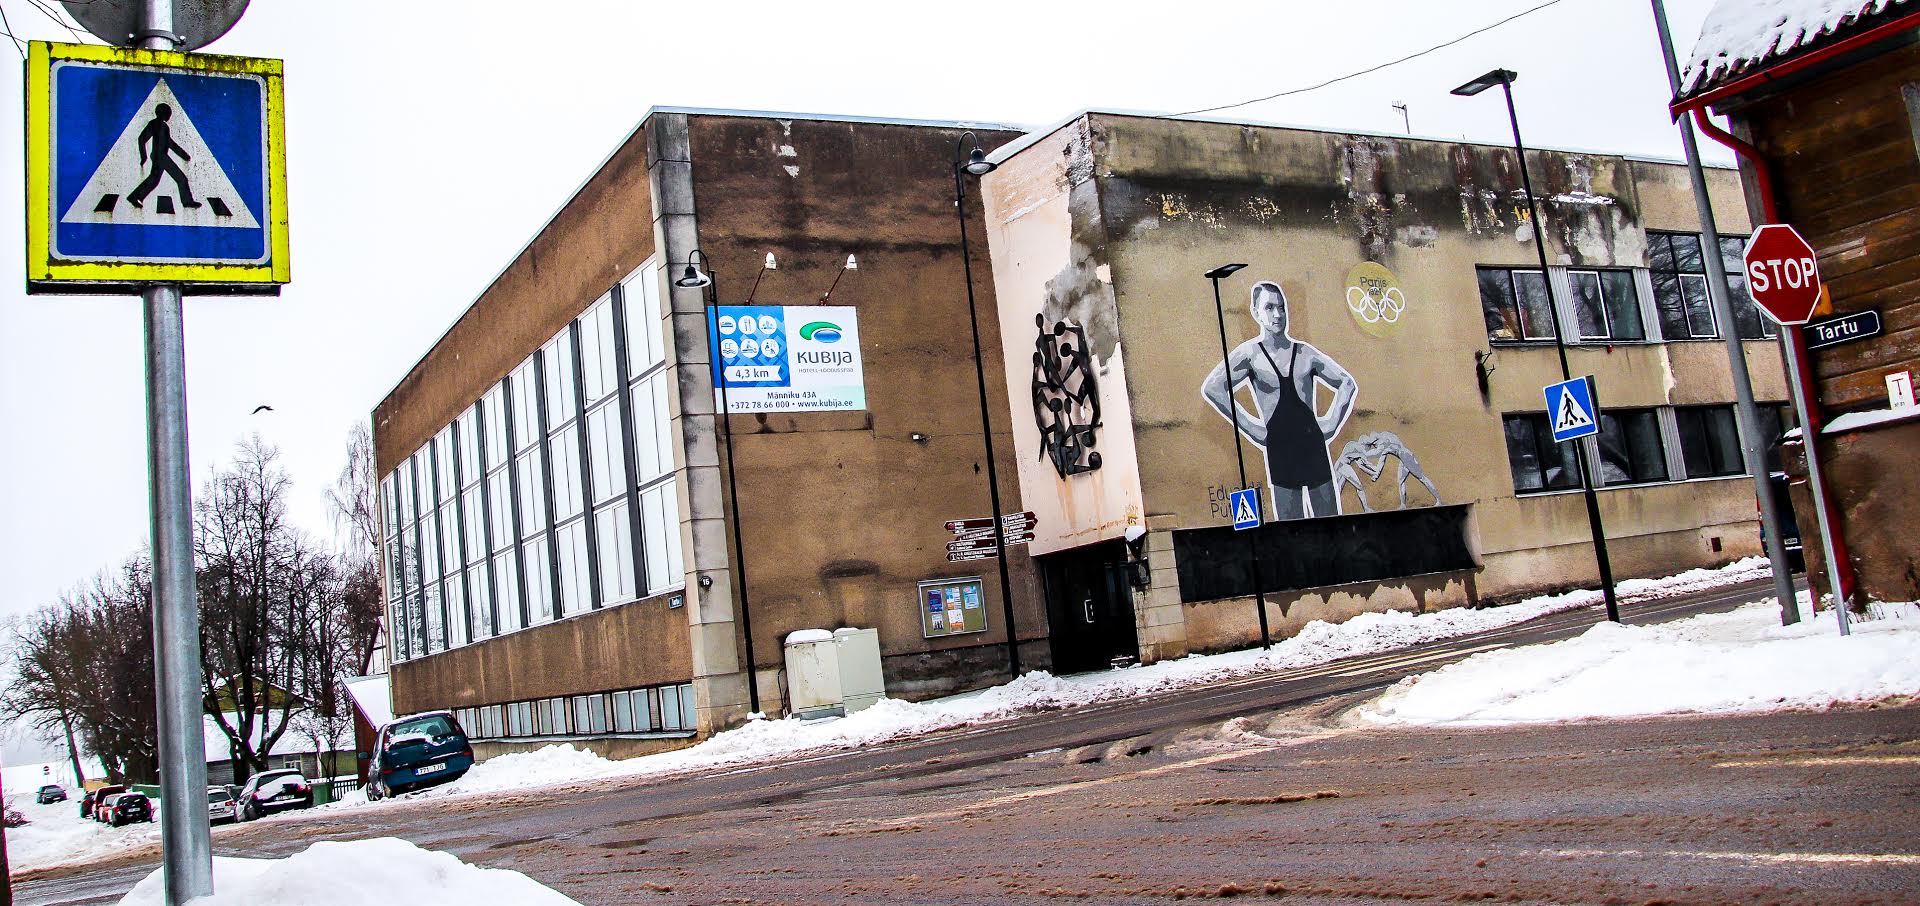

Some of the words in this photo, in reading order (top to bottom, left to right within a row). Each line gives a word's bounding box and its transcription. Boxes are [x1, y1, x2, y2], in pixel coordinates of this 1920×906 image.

[1750, 258, 1815, 292] STOP
[1816, 319, 1859, 341] Tartu
[735, 369, 750, 380] 4,3
[753, 368, 769, 378] km
[767, 391, 800, 399] Männiku
[802, 391, 817, 399] 43A
[730, 401, 750, 409] +372
[775, 400, 790, 408] 000
[797, 398, 853, 408] www.kubija.ee
